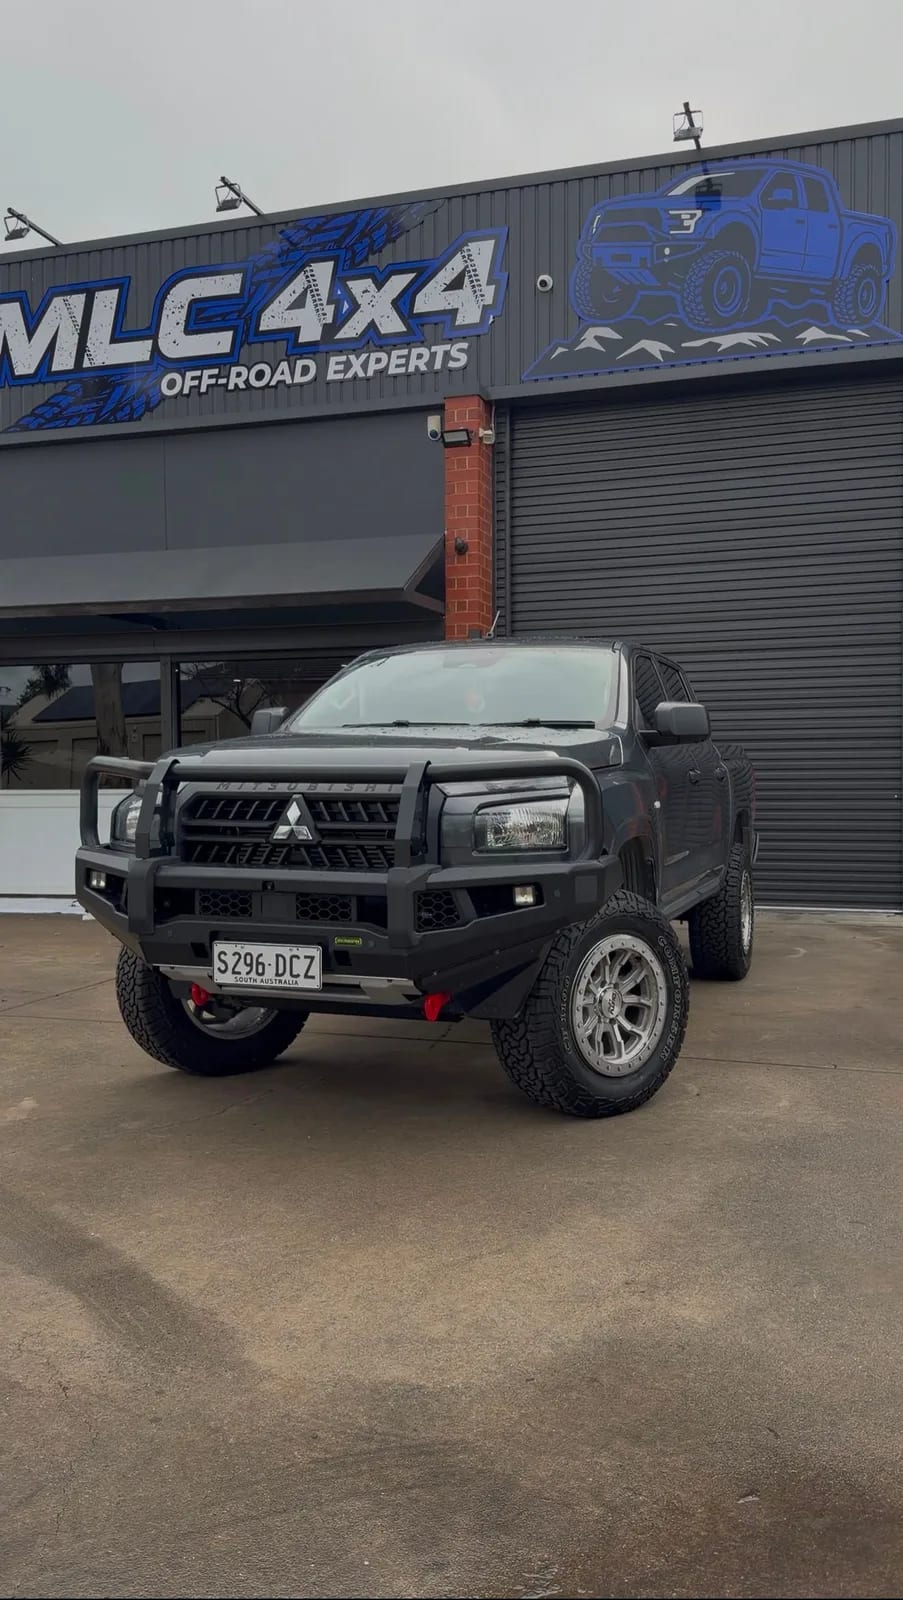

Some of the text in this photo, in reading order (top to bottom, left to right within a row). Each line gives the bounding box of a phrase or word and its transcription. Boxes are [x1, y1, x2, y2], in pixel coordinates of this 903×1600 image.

[0, 239, 496, 376] MLC 4x4
[160, 342, 469, 397] OFF-ROAD EXPERTS
[234, 976, 299, 986] SOUTH AUSTRALIA
